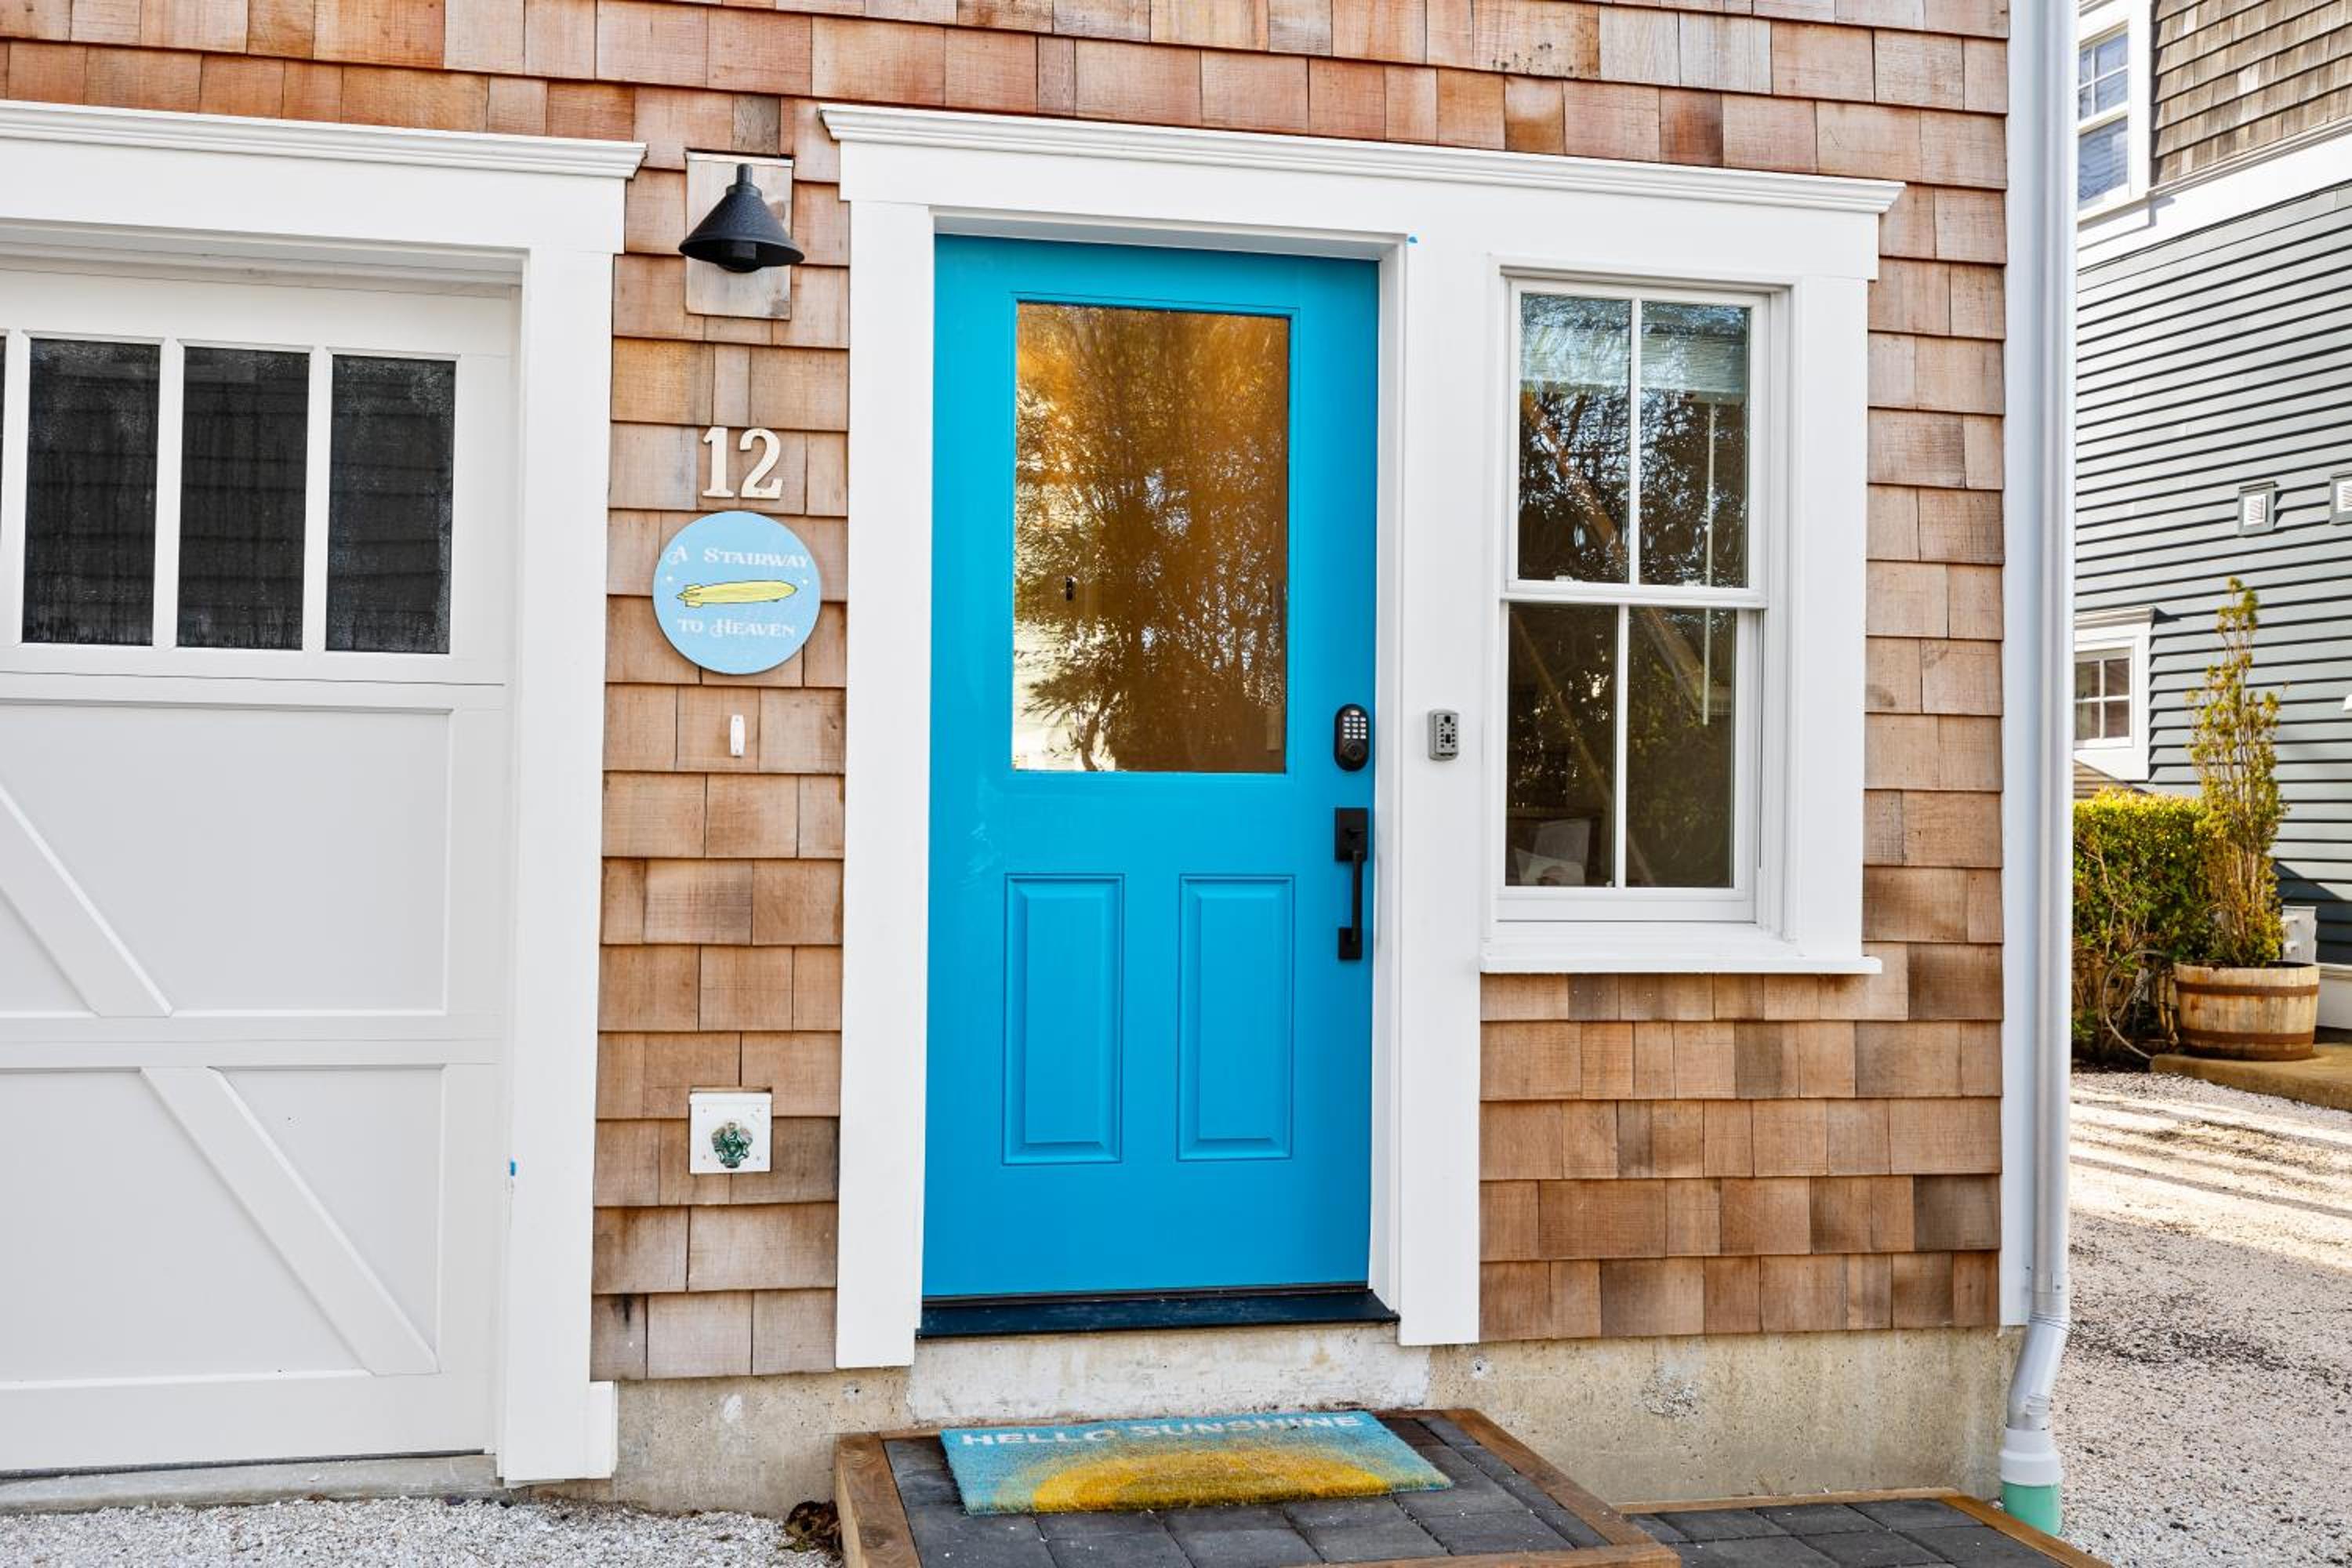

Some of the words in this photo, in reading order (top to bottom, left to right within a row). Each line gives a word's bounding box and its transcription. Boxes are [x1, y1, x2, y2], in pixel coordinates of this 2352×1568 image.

[702, 426, 782, 499] 12
[667, 545, 688, 565] A
[703, 546, 811, 568] STAIRWAY
[677, 619, 703, 633] TO
[710, 618, 796, 638] HEAVEN
[962, 1428, 1117, 1446] HELLO
[1129, 1416, 1363, 1437] SUNSHINE
